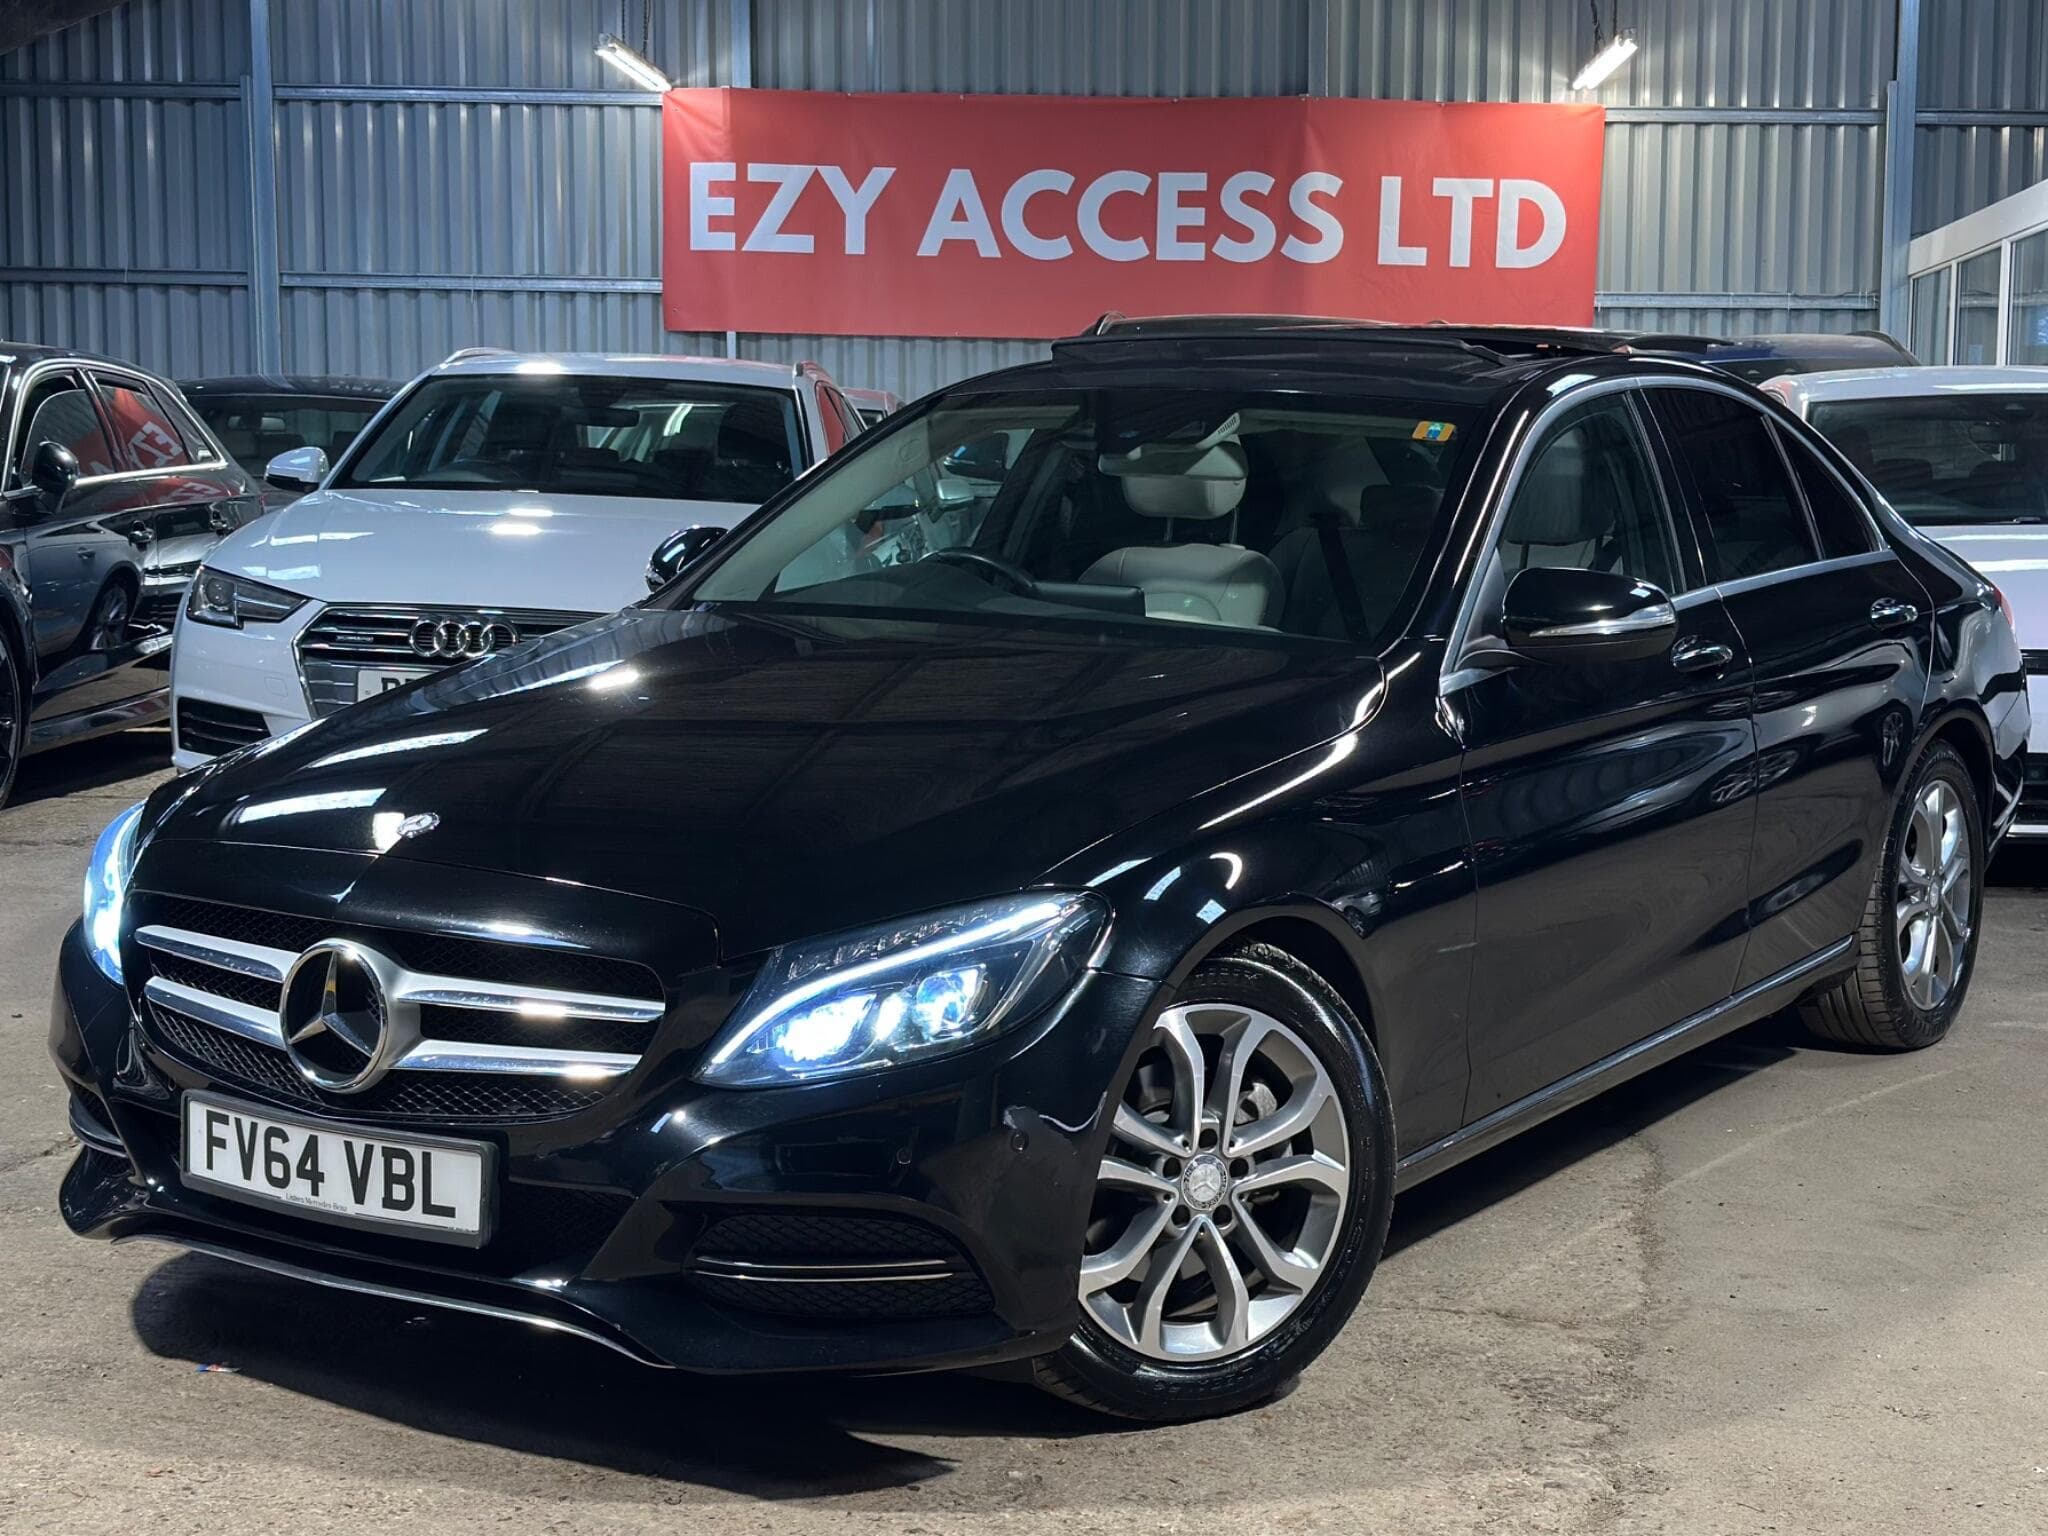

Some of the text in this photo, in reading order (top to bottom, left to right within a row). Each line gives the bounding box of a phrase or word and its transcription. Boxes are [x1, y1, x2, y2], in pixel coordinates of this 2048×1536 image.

[690, 162, 1567, 269] EZY ACCESS LTD
[206, 1109, 456, 1218] FV64 VBL
